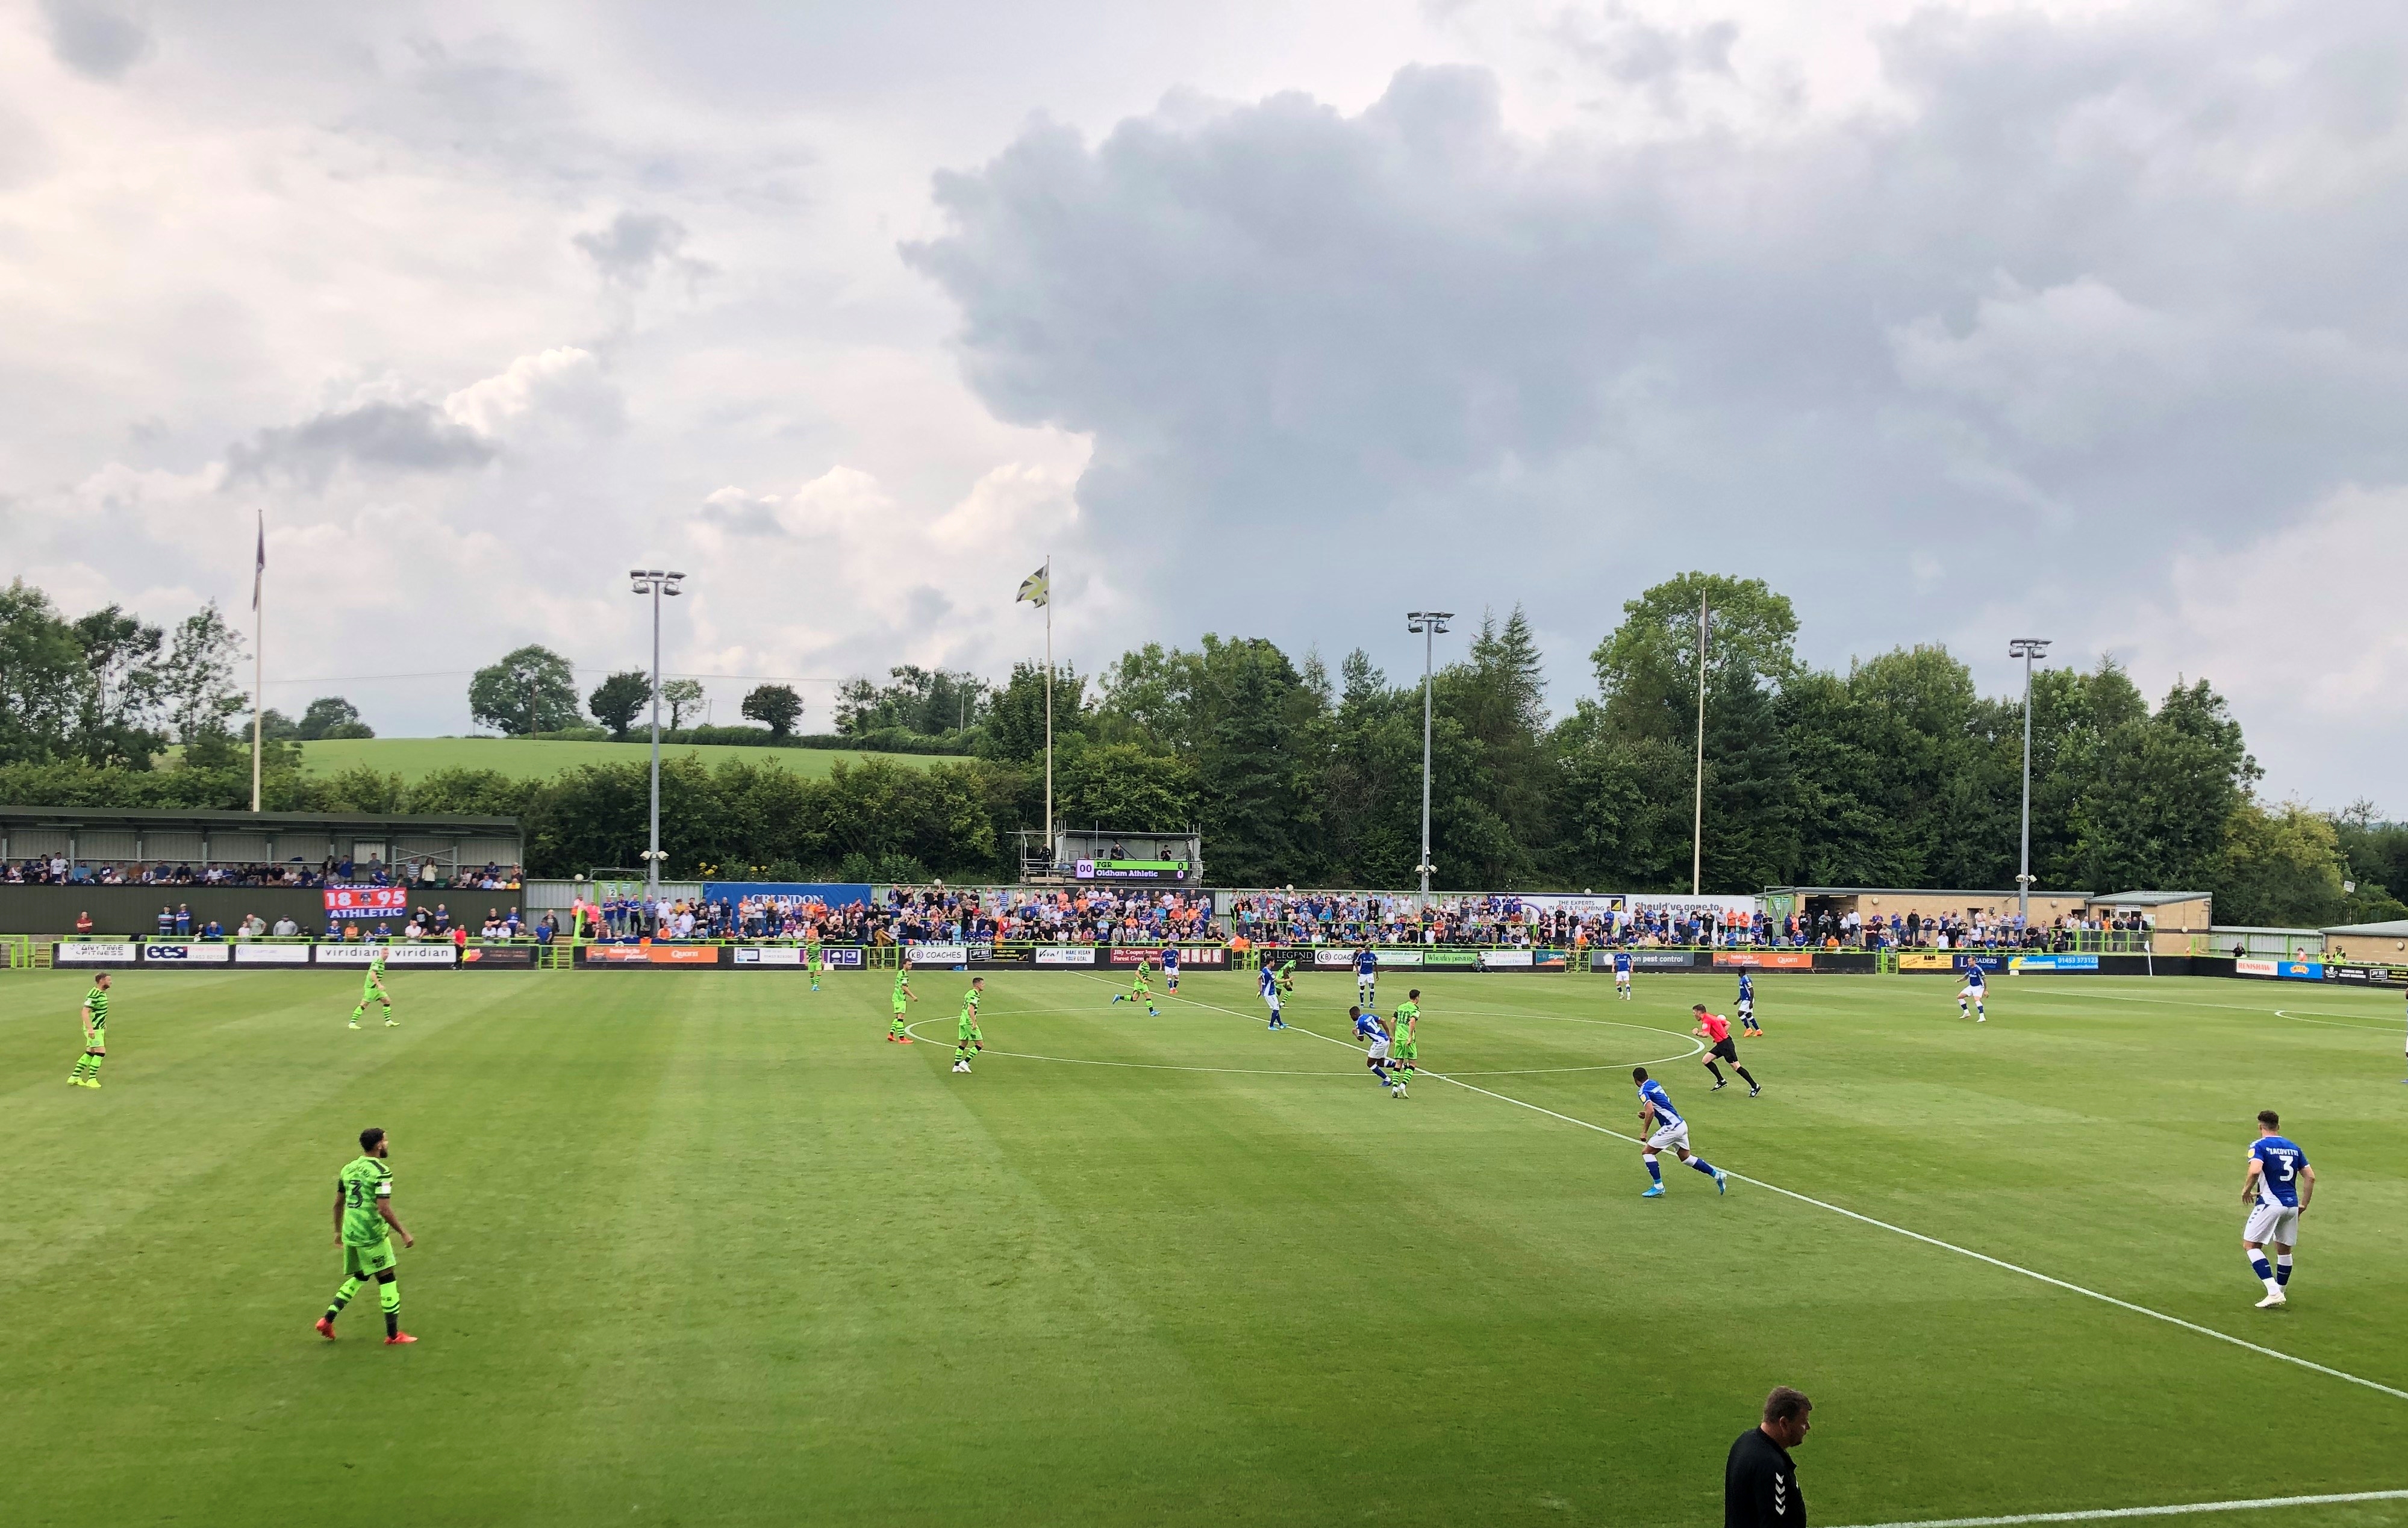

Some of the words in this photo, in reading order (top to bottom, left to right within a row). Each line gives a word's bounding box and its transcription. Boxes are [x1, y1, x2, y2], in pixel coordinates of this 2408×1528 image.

[1177, 870, 1184, 879] 0
[326, 891, 352, 906] 18
[377, 890, 406, 905] 95
[329, 908, 403, 918] ATHLETIC
[325, 947, 379, 956] viridian
[395, 948, 448, 956] viridian
[1038, 949, 1059, 958] Viva!
[1276, 950, 1314, 959] LEGEND
[1642, 956, 1659, 964] pest
[2238, 962, 2271, 971] RENISHAW
[1398, 1011, 1411, 1024] 10
[2279, 1155, 2294, 1182] 3
[347, 1179, 363, 1209] 3
